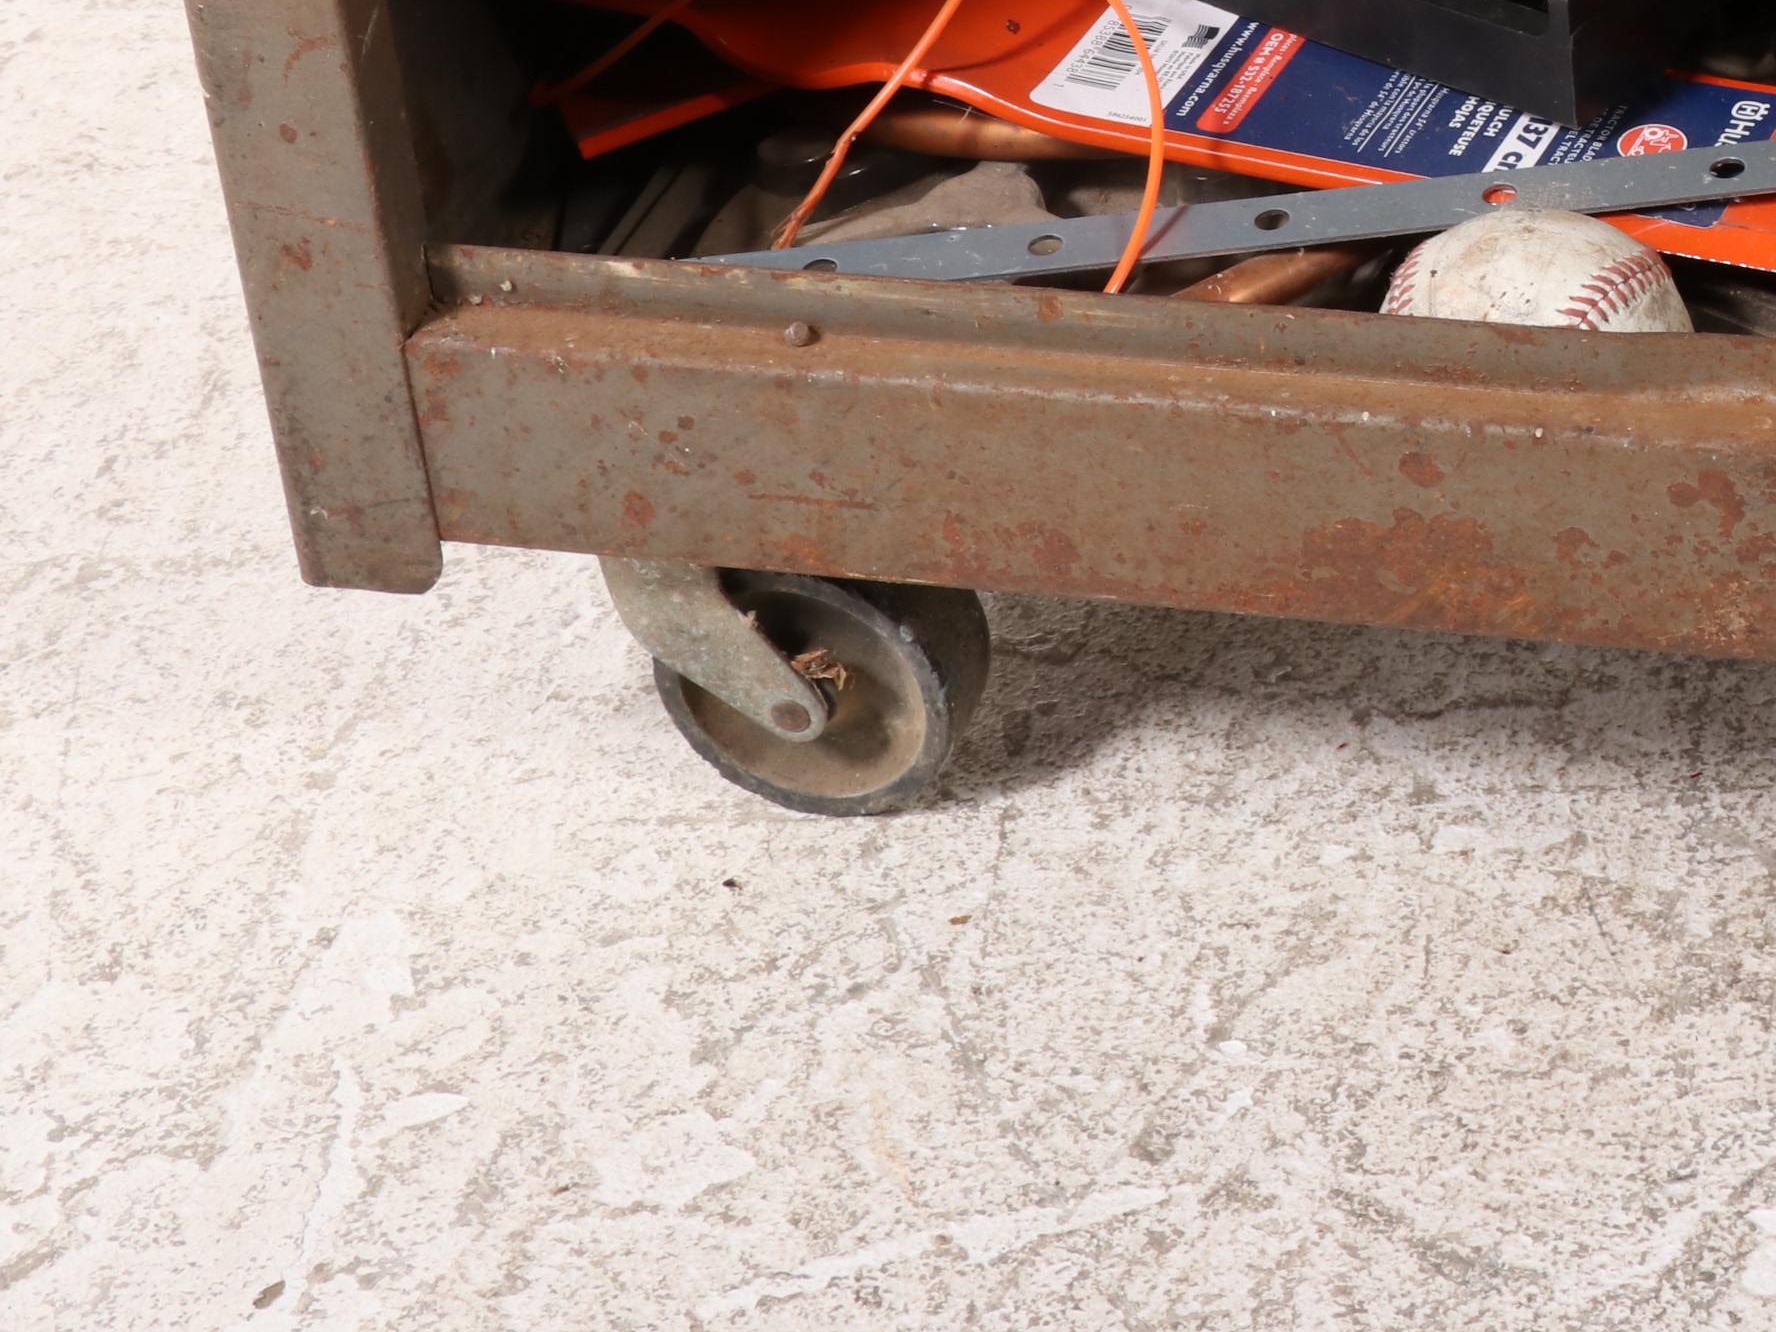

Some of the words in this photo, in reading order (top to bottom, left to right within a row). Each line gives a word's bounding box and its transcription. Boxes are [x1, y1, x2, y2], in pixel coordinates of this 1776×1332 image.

[1089, 19, 1121, 46] 85388
[1256, 32, 1287, 56] OEM
[1064, 47, 1096, 74] 64438
[1171, 20, 1264, 117] www.husqvarna.com
[1211, 64, 1262, 114] 532-187255
[1444, 94, 1481, 128] HOJAS
[1446, 100, 1498, 157] IQUETEUSE
[1594, 104, 1629, 141] TRACTOR
[1562, 128, 1594, 164] TRACTEU
[1578, 140, 1603, 163] BLAD
